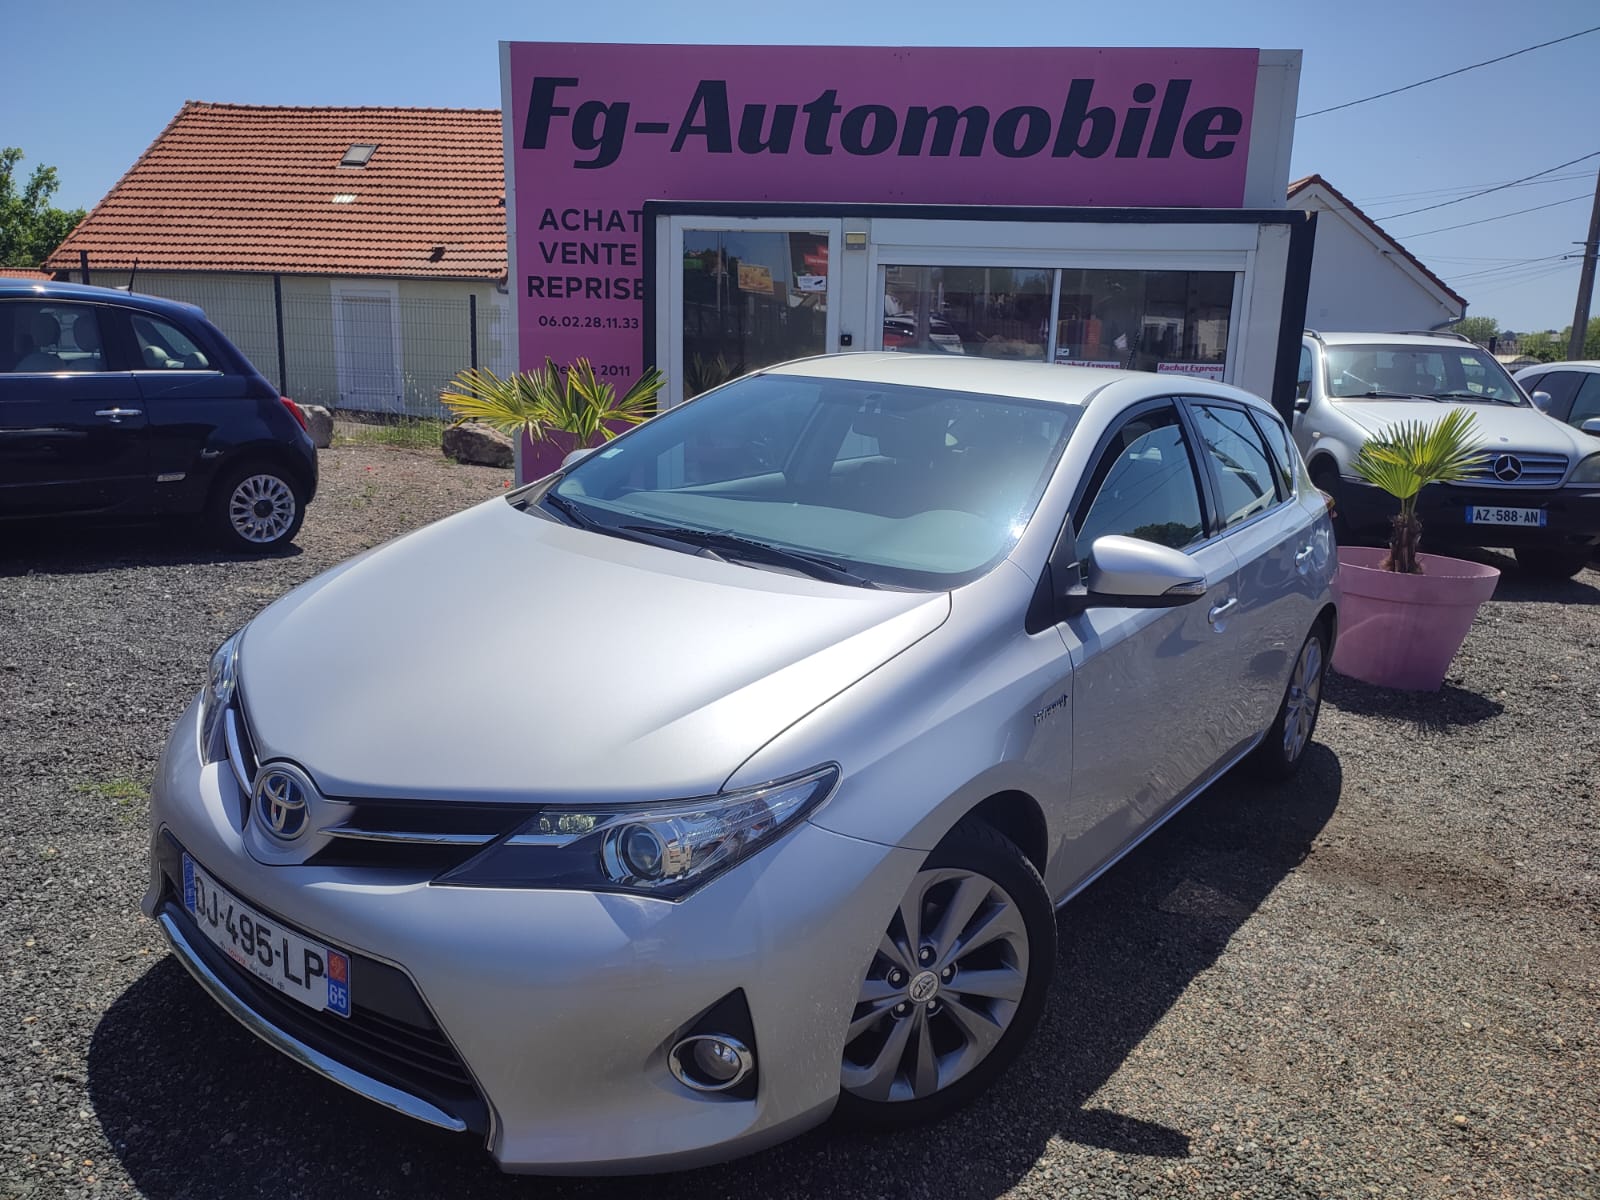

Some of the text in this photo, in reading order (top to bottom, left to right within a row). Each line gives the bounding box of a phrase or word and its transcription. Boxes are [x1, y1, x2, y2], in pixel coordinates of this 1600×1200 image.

[522, 77, 1243, 170] Fg-Automobile
[538, 208, 643, 233] ACHAT
[538, 241, 637, 266] VENTE
[527, 275, 644, 300] REPRISE
[538, 315, 639, 329] 06.02.28.11.33
[601, 365, 630, 377] 2011
[329, 983, 347, 1009] 65
